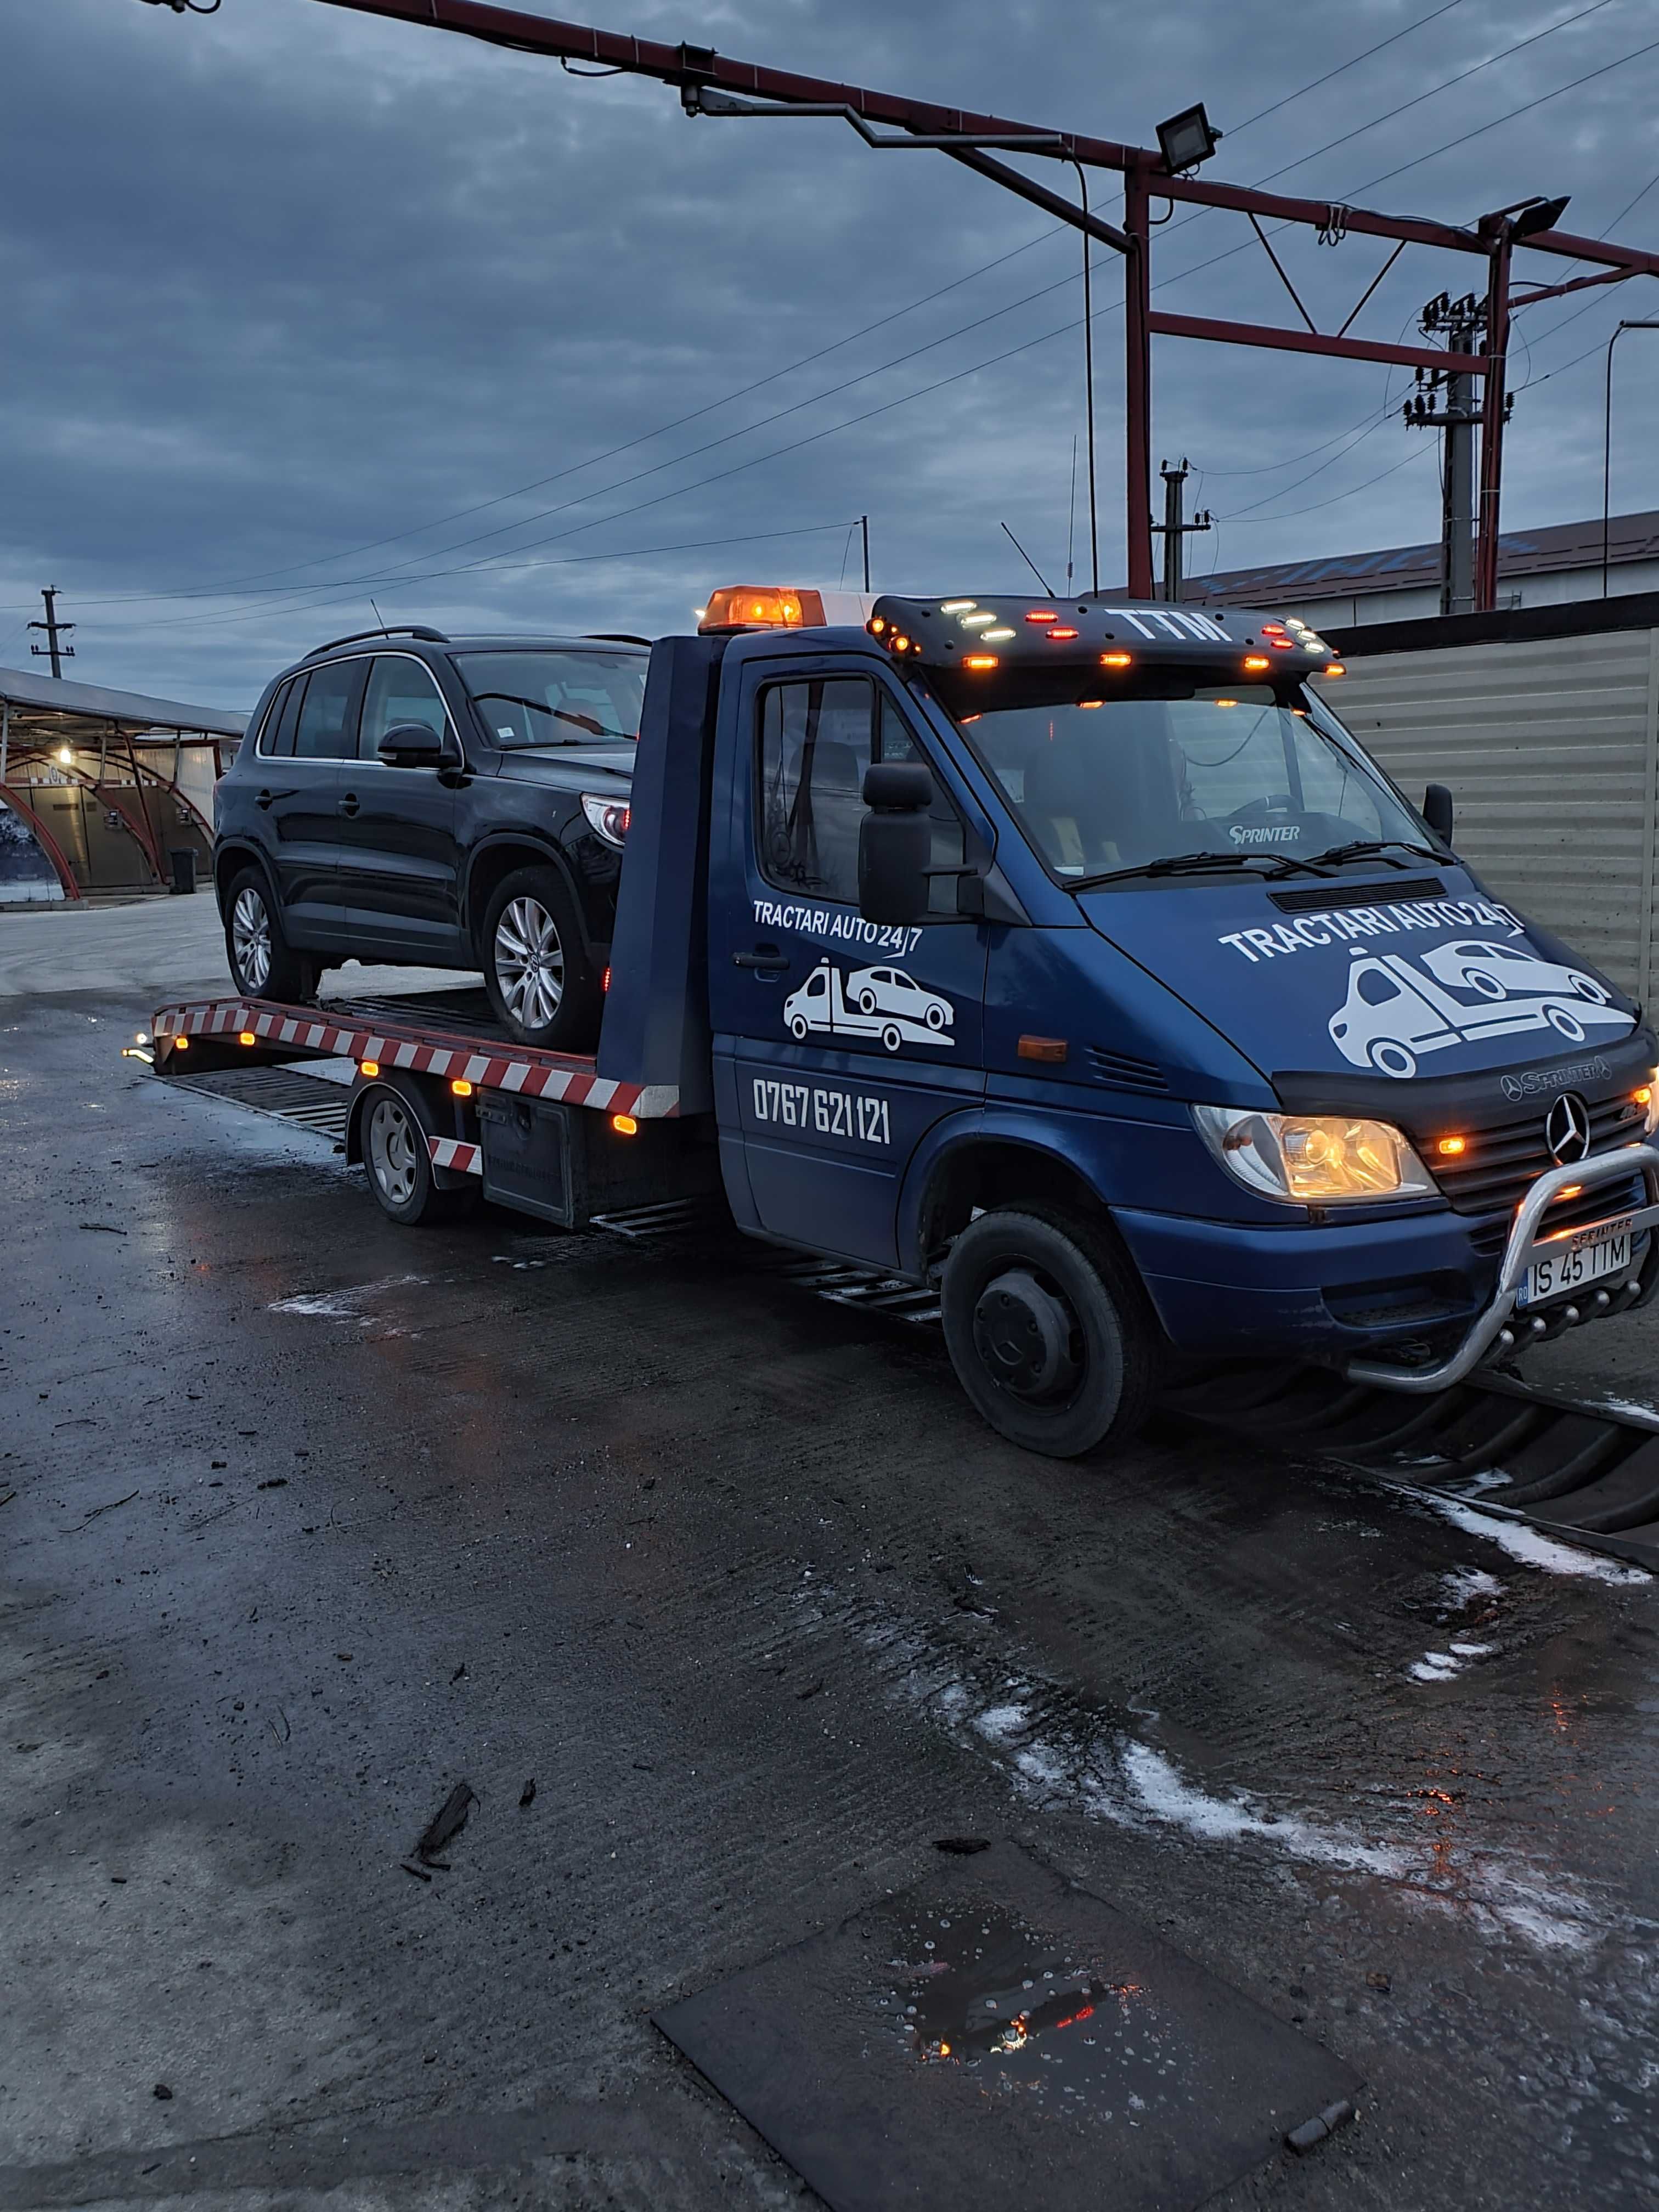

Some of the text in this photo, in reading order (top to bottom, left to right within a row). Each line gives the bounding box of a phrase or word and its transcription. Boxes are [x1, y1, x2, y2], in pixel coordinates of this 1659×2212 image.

[1103, 608, 1233, 642] TTM
[1229, 825, 1301, 845] SPRINTER
[753, 900, 923, 959] TRACTARI AUTO 24/7
[1217, 902, 1526, 963] TRACTARI AUTO 24/7
[1520, 1062, 1600, 1094] SPRINTER
[753, 1078, 809, 1128] 0767
[1571, 1218, 1633, 1251] SPRINTER
[1533, 1235, 1625, 1297] IS 45 TTM
[1518, 1286, 1528, 1301] RO
